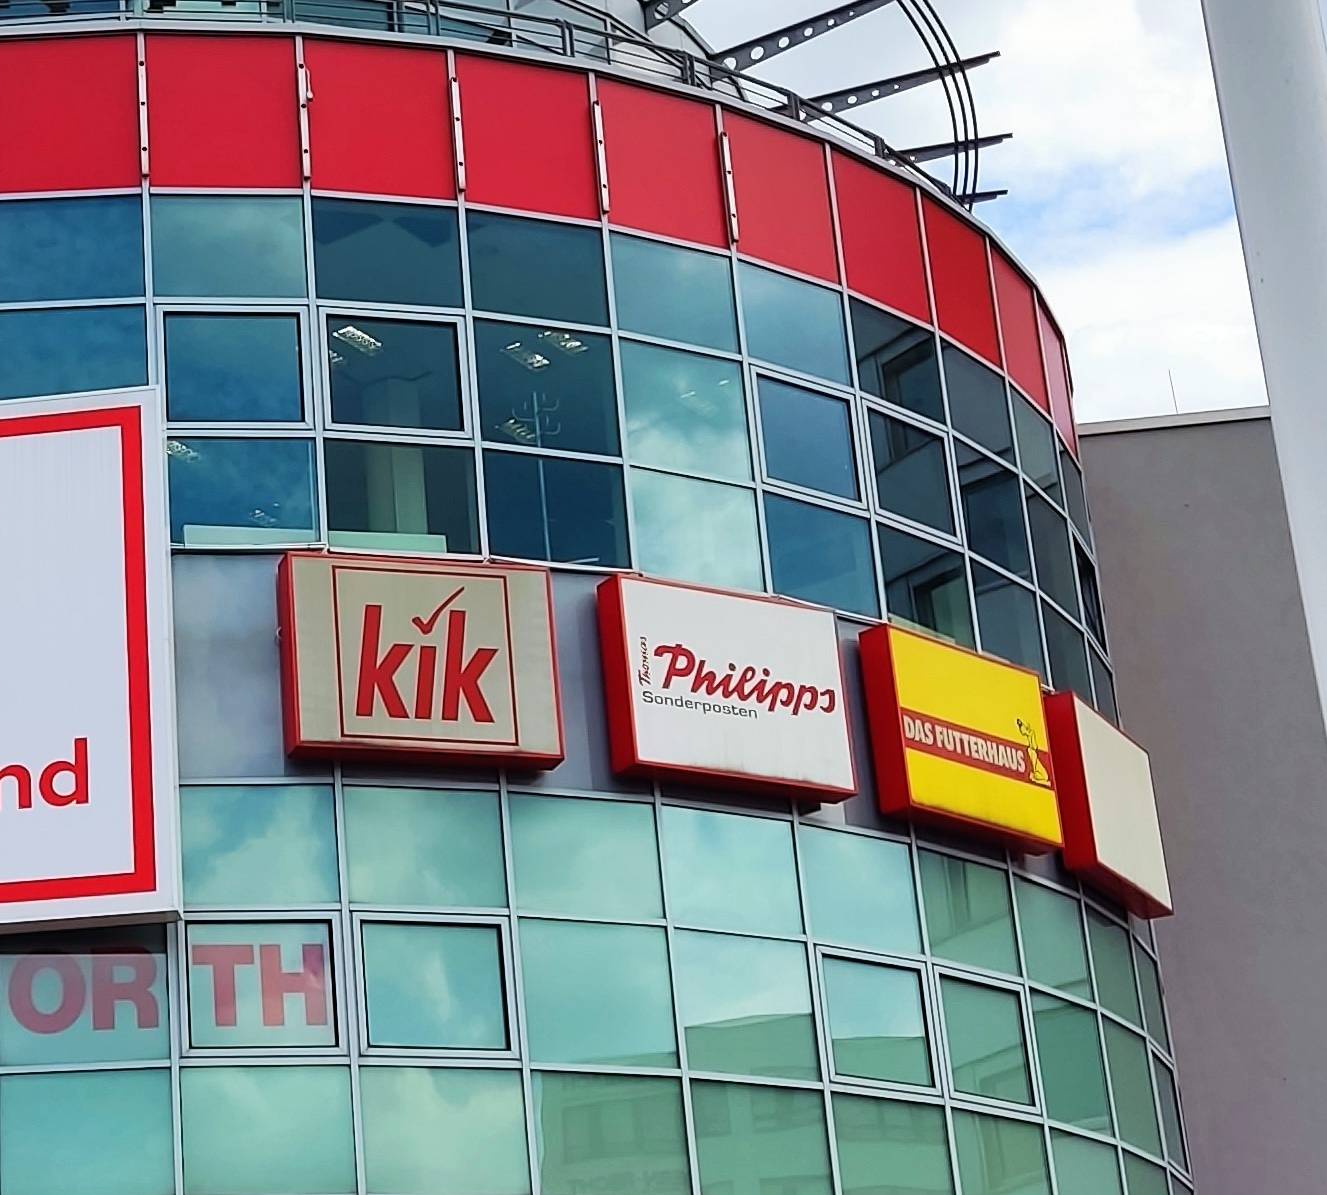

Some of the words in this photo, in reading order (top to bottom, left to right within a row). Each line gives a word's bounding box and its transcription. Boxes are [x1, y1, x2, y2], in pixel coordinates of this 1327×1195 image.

[638, 637, 652, 686] Thomas
[654, 643, 836, 715] Philipps
[642, 690, 758, 719] Sonderposten
[902, 714, 934, 745] DAS
[934, 725, 1026, 772] FUTTERHAUS
